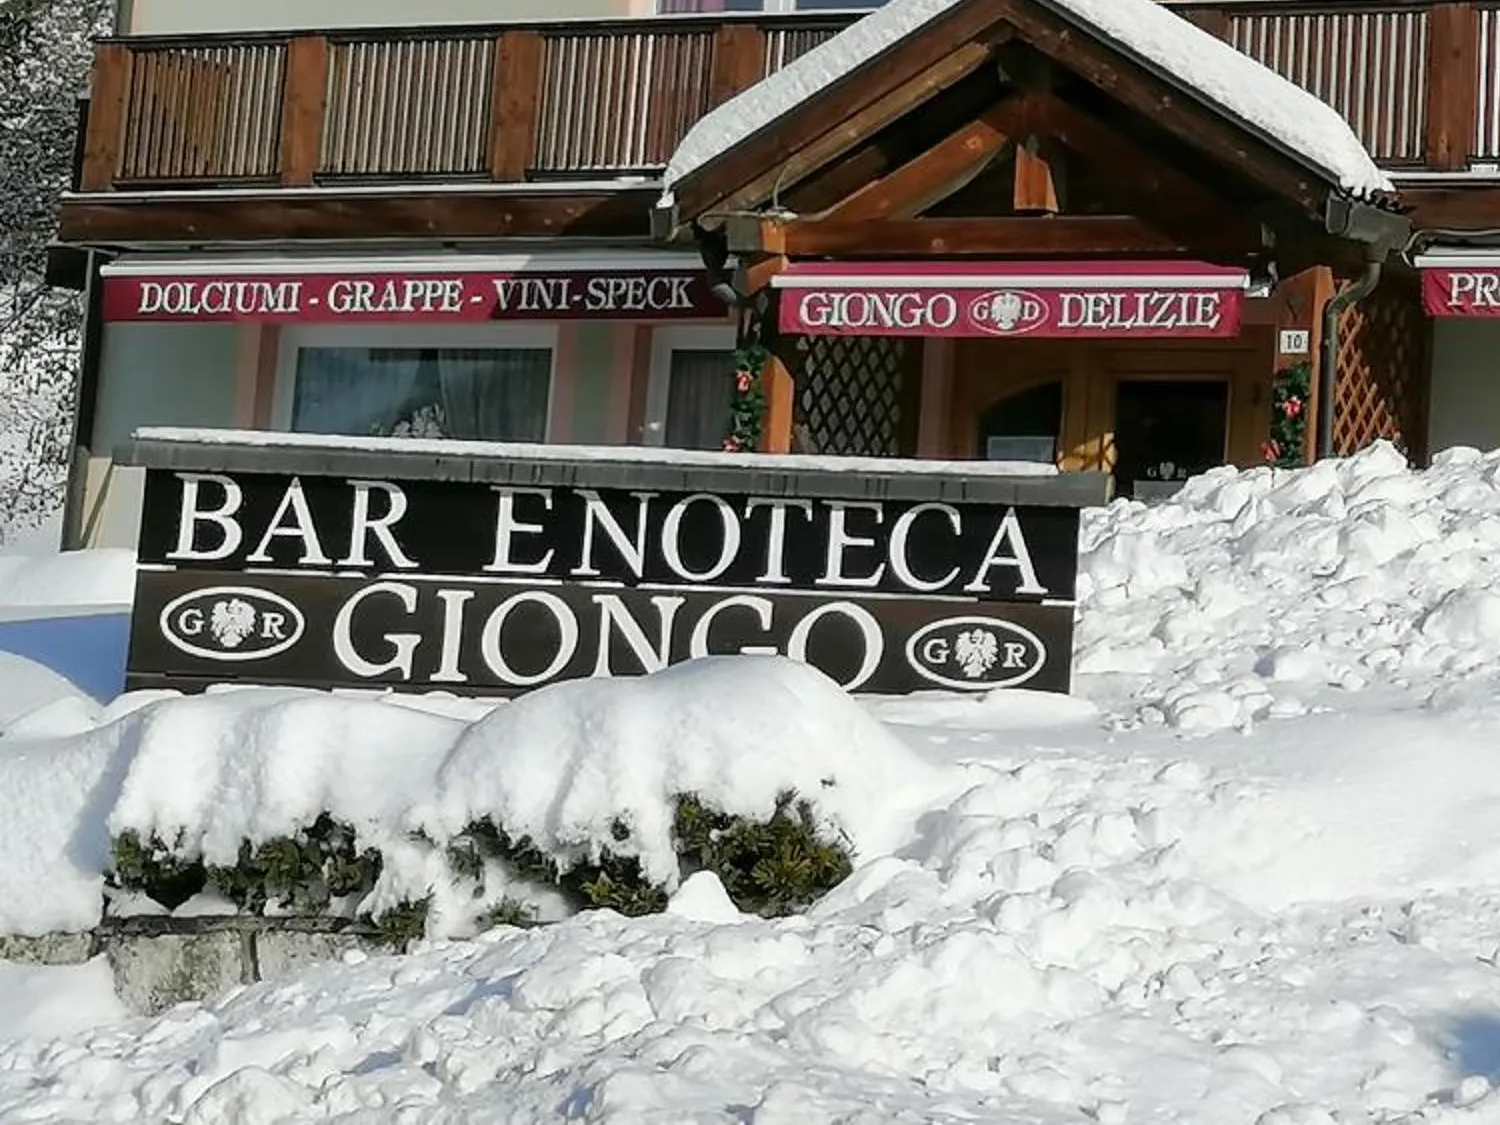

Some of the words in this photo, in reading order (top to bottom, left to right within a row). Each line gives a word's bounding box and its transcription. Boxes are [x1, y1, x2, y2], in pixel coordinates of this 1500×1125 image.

[138, 280, 301, 314] DOLCIUMI
[327, 279, 464, 313] GRAPPE
[799, 292, 957, 329] GIONGO
[1057, 290, 1222, 329] DELIZIE
[1287, 334, 1302, 350] 10
[167, 472, 420, 569] BAR
[484, 485, 1050, 594] ENOTECA
[333, 581, 885, 693] GIONGO
